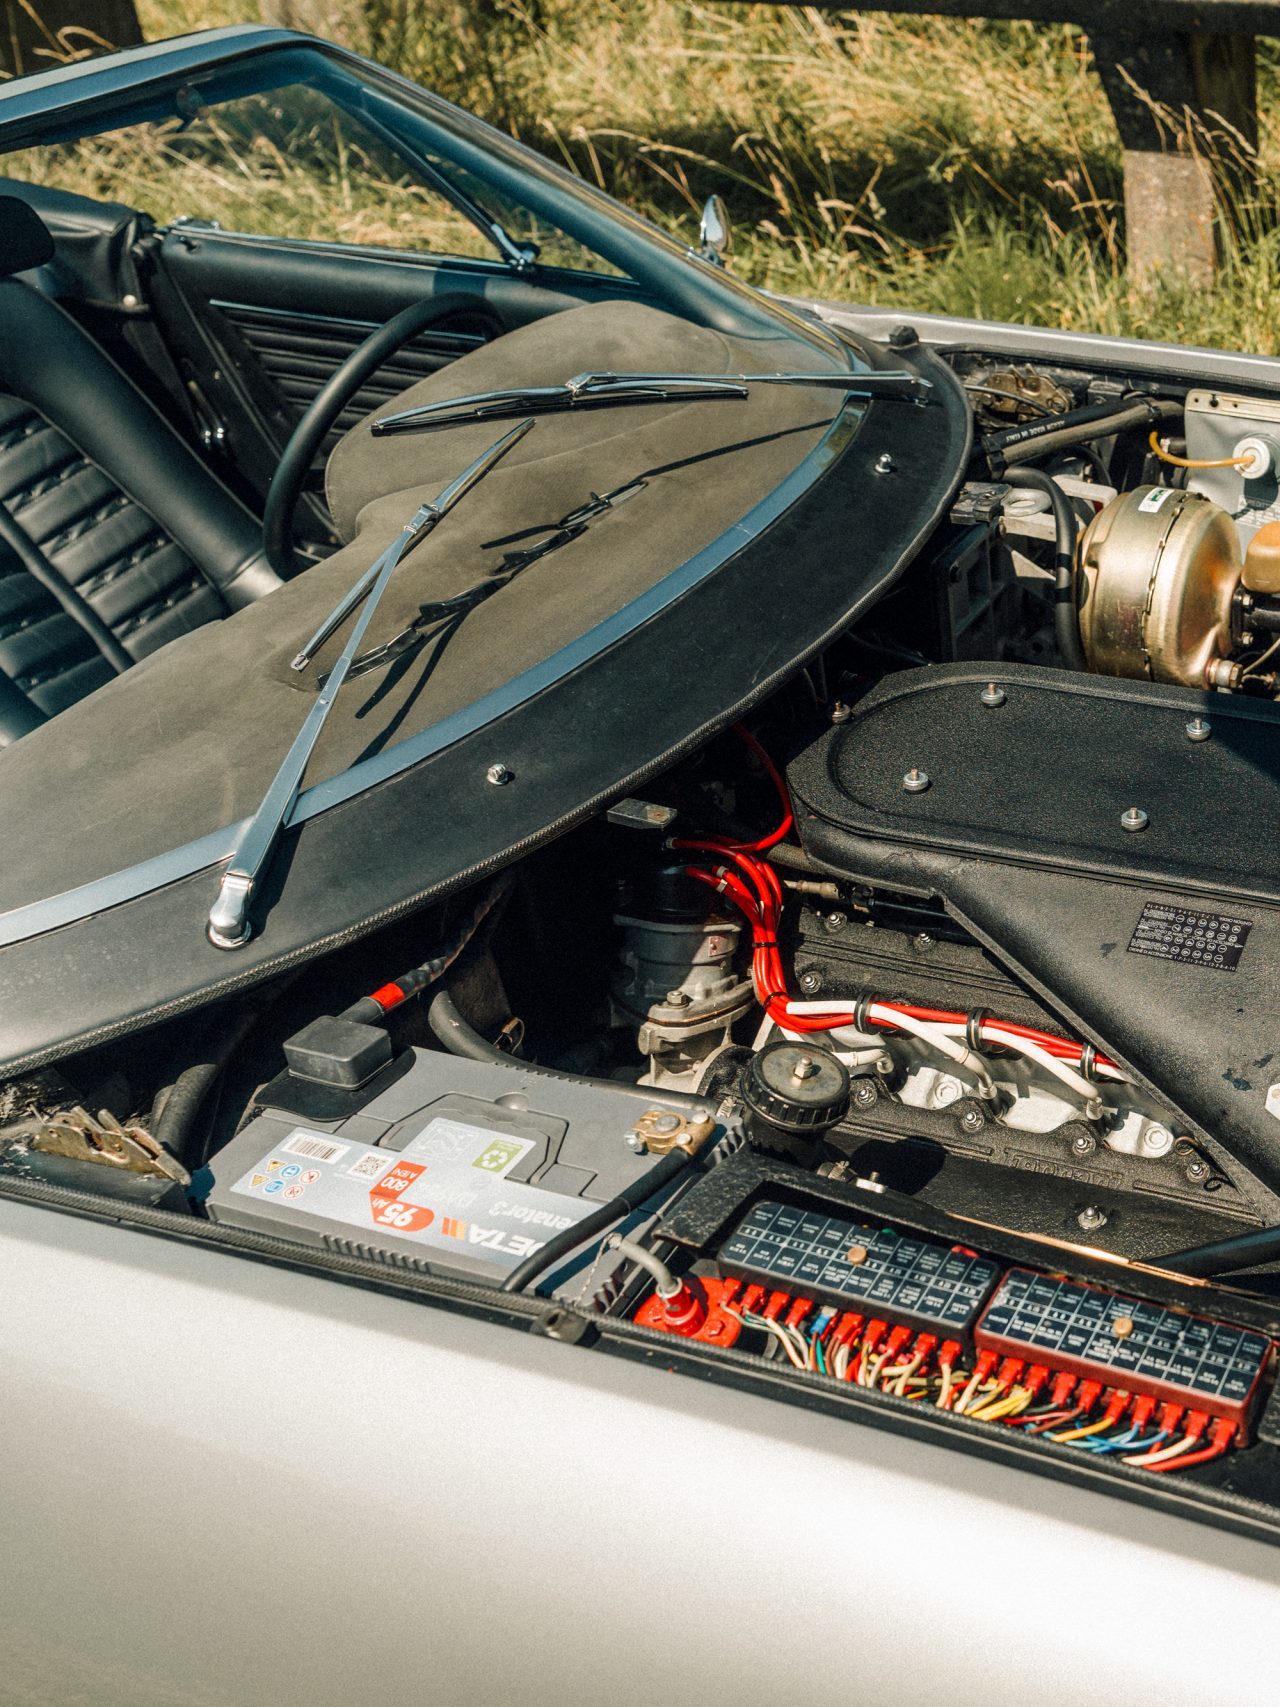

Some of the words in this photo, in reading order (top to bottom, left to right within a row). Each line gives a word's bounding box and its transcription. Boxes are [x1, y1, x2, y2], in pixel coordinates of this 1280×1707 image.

[380, 1176, 409, 1192] 800
[371, 1197, 391, 1209] Ah
[376, 1203, 418, 1228] 95
[488, 1201, 578, 1231] enator3
